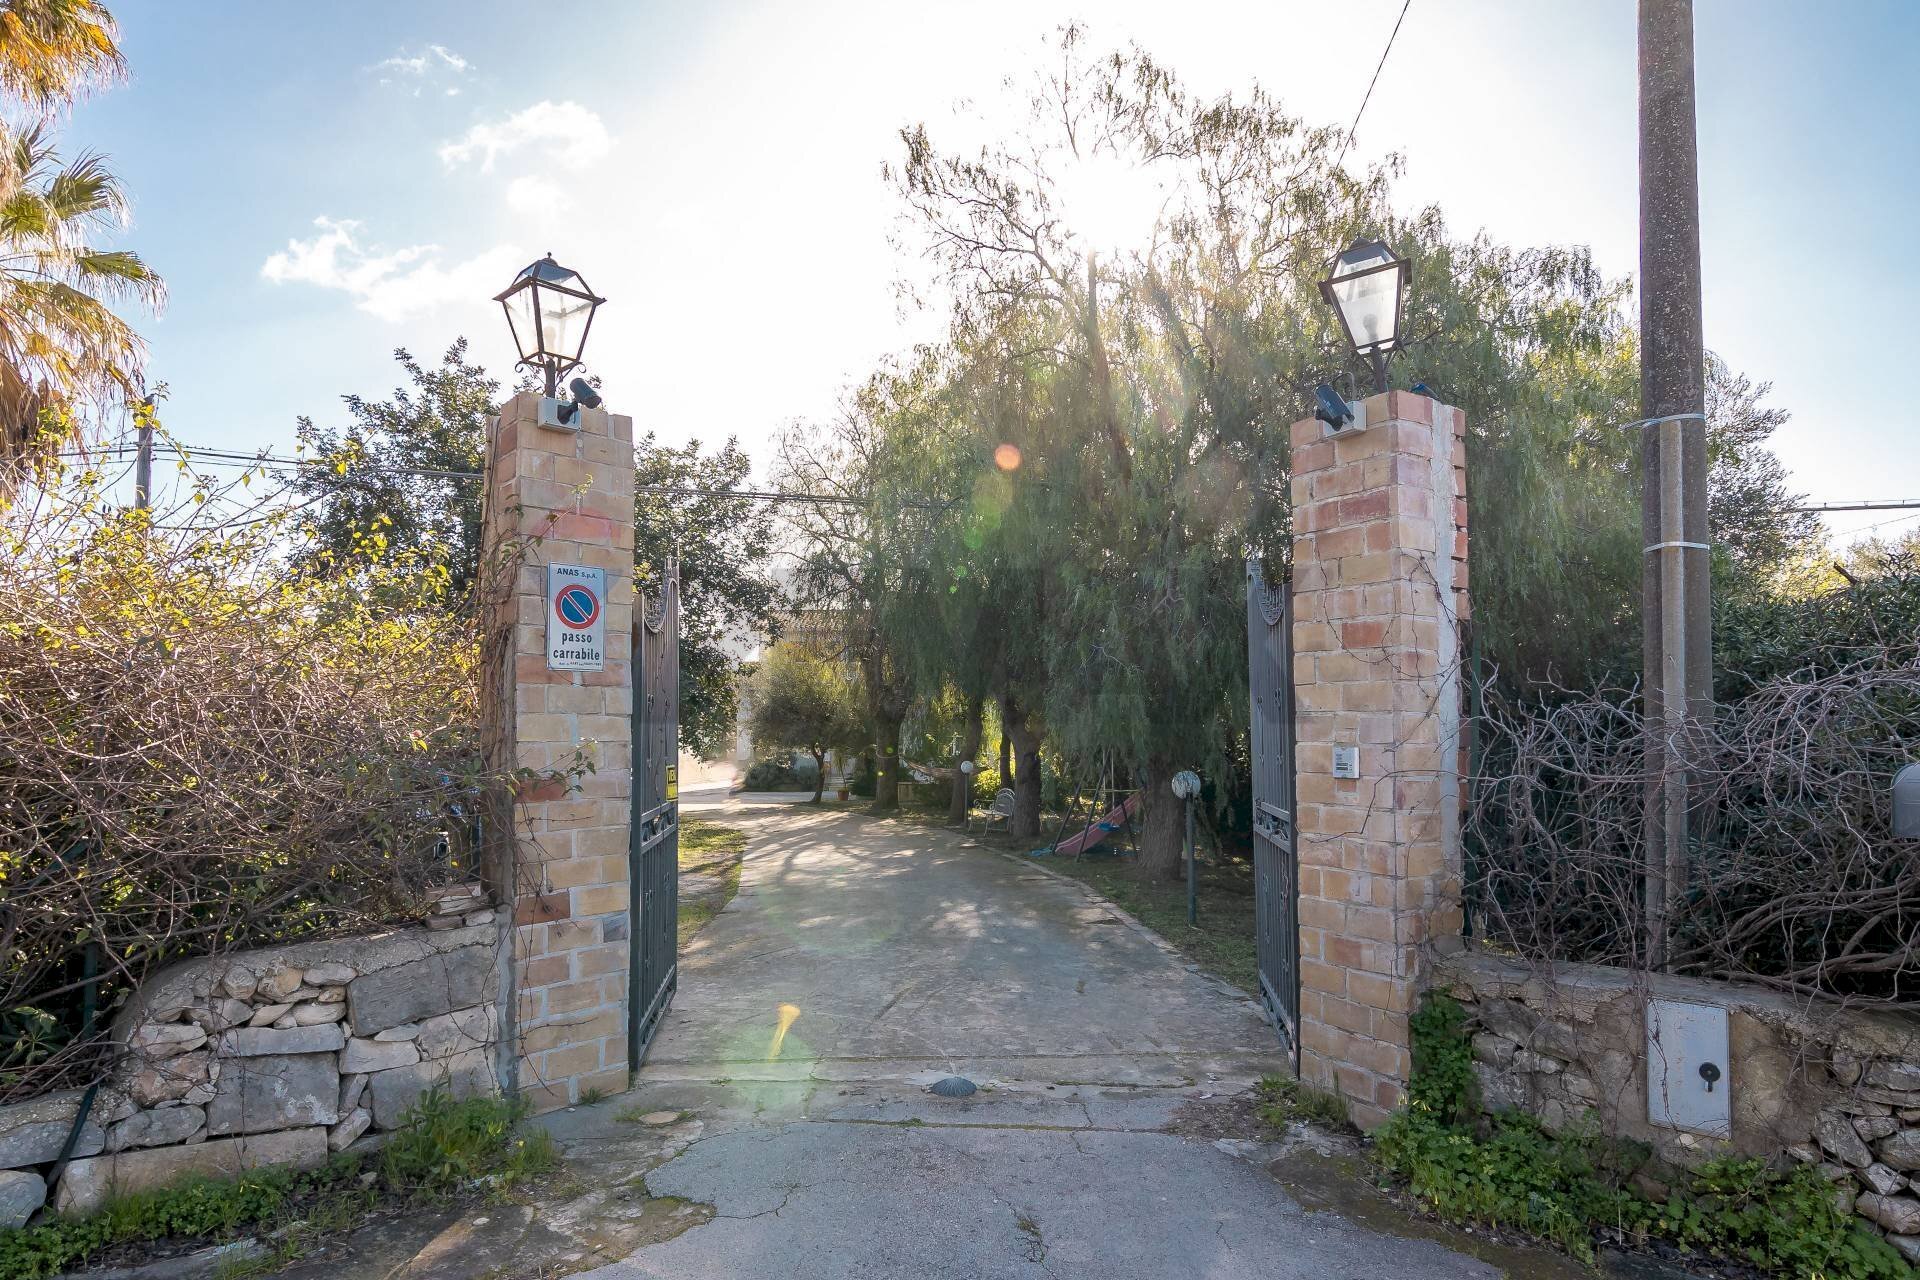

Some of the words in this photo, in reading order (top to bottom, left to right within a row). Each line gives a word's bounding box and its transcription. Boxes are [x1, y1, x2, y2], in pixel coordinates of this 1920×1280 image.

[557, 568, 579, 577] ANAS
[562, 633, 592, 645] passo
[553, 648, 600, 661] carrabile
